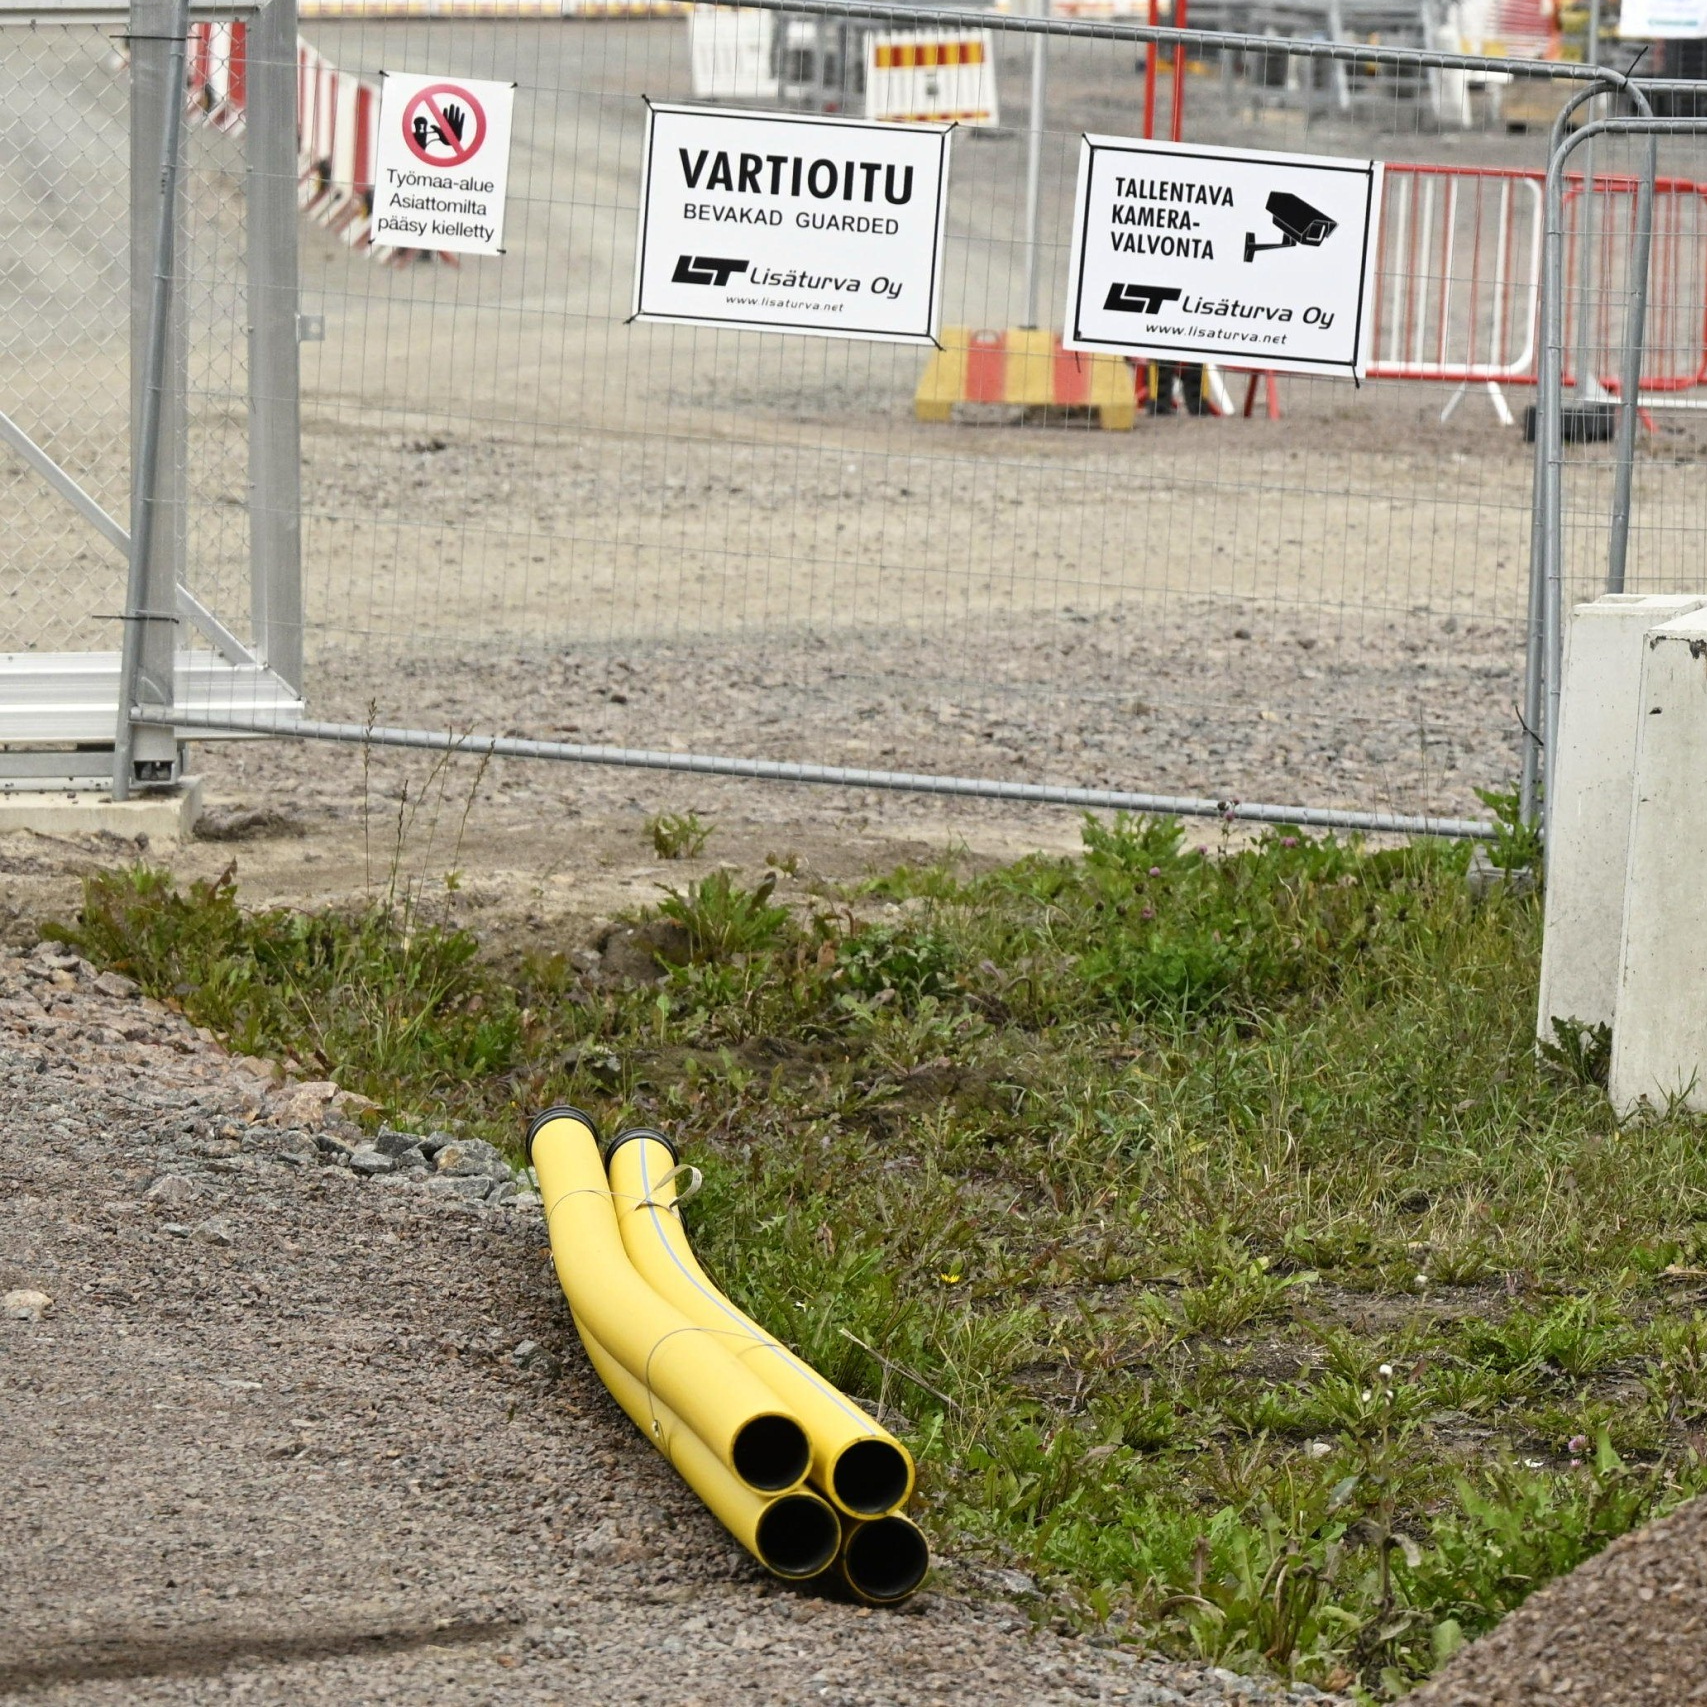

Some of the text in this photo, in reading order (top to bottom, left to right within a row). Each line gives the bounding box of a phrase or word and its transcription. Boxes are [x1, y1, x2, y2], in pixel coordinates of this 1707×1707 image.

[387, 169, 494, 194] Työmaa-alue
[679, 148, 913, 207] VARTIOITU
[390, 193, 486, 215] Asiattomilta
[1115, 177, 1233, 206] TALLENTAVA
[378, 216, 494, 242] pääsy kielletty
[684, 203, 898, 235] BEVAKAD GUARDED
[1112, 205, 1200, 230] KAMERA-
[1111, 231, 1213, 260] VALVONTA
[750, 267, 860, 292] Lisäturva
[871, 277, 902, 299] Oy
[726, 297, 843, 312] www.lisaturva.net
[1182, 296, 1293, 322] Lisäturva
[1303, 307, 1334, 329] Oy
[1146, 325, 1287, 344] www.lisaturva.net
